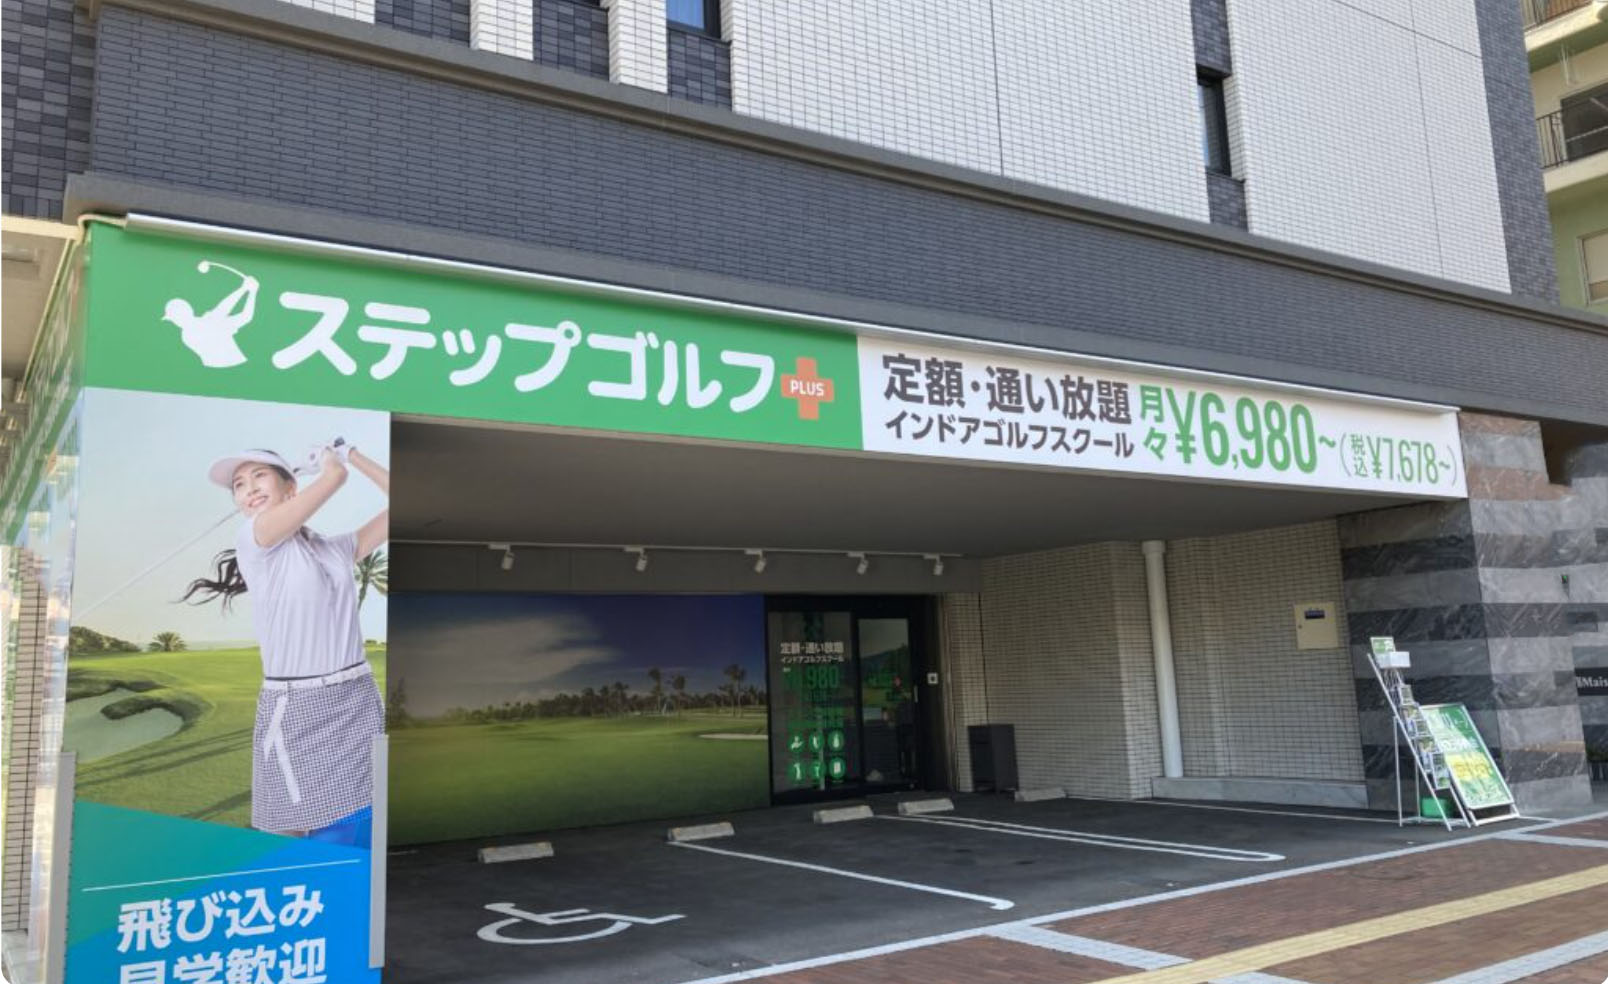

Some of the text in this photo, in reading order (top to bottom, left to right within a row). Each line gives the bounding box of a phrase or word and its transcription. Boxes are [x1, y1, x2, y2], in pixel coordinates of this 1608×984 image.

[272, 290, 776, 413] ステップゴルフ
[790, 379, 825, 397] PLUS
[885, 411, 1135, 458] インドアゴルフスクール
[117, 885, 325, 953] 飛び込み
